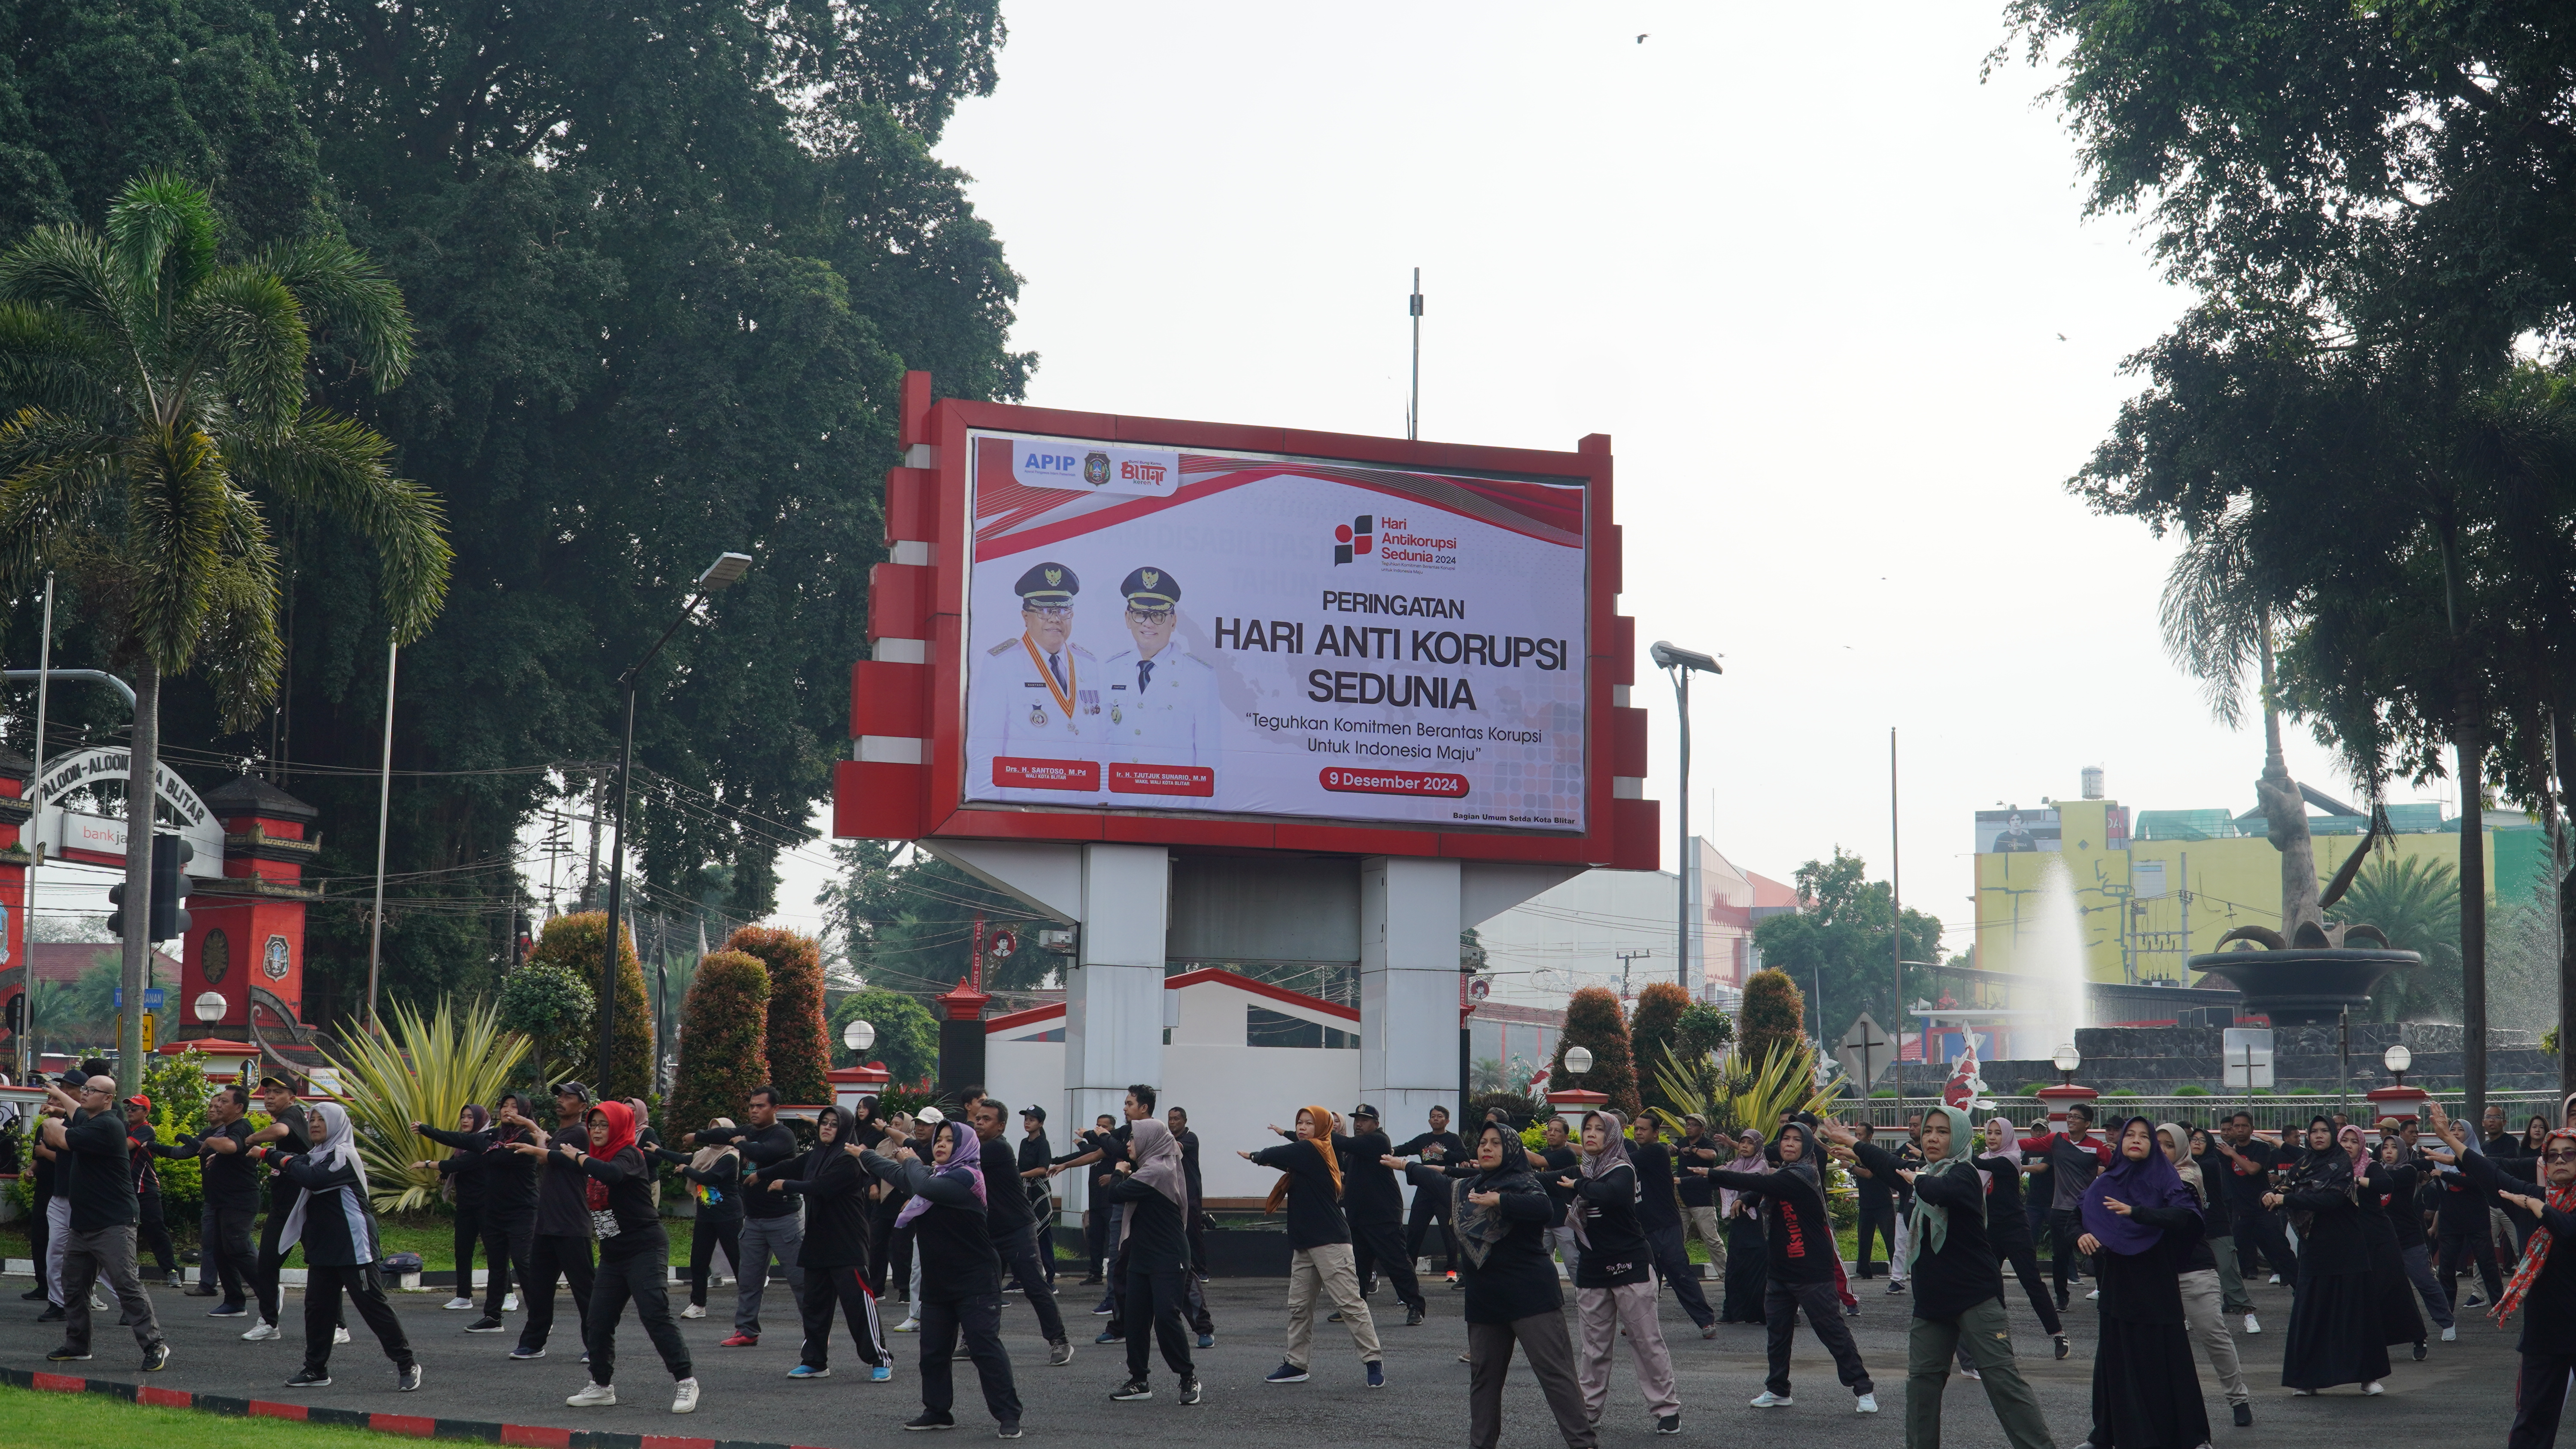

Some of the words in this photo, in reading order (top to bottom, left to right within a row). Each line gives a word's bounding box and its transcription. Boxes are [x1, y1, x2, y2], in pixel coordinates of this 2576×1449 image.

[1025, 453, 1075, 471] APIP
[1382, 516, 1406, 530] Hari
[1382, 532, 1457, 552] Antikorupsi
[1381, 547, 1433, 563] Sedunia
[1435, 555, 1456, 564] 2024
[1323, 590, 1464, 619] PERINGATAN
[1215, 617, 1303, 654] HARI
[1314, 624, 1400, 660] ANTI
[1412, 630, 1567, 671] KORUPSI
[1308, 669, 1477, 711] SEDUNIA
[1334, 717, 1411, 735] Komitmen
[1417, 722, 1483, 740] Berantas
[1488, 727, 1542, 745] Korupsi
[1308, 737, 1350, 754] Untuk
[1355, 740, 1431, 758] Indonesia
[1329, 772, 1339, 785] 9
[1343, 773, 1420, 789] Desember
[1423, 777, 1458, 791] 2024
[166, 777, 205, 825] BLITAR
